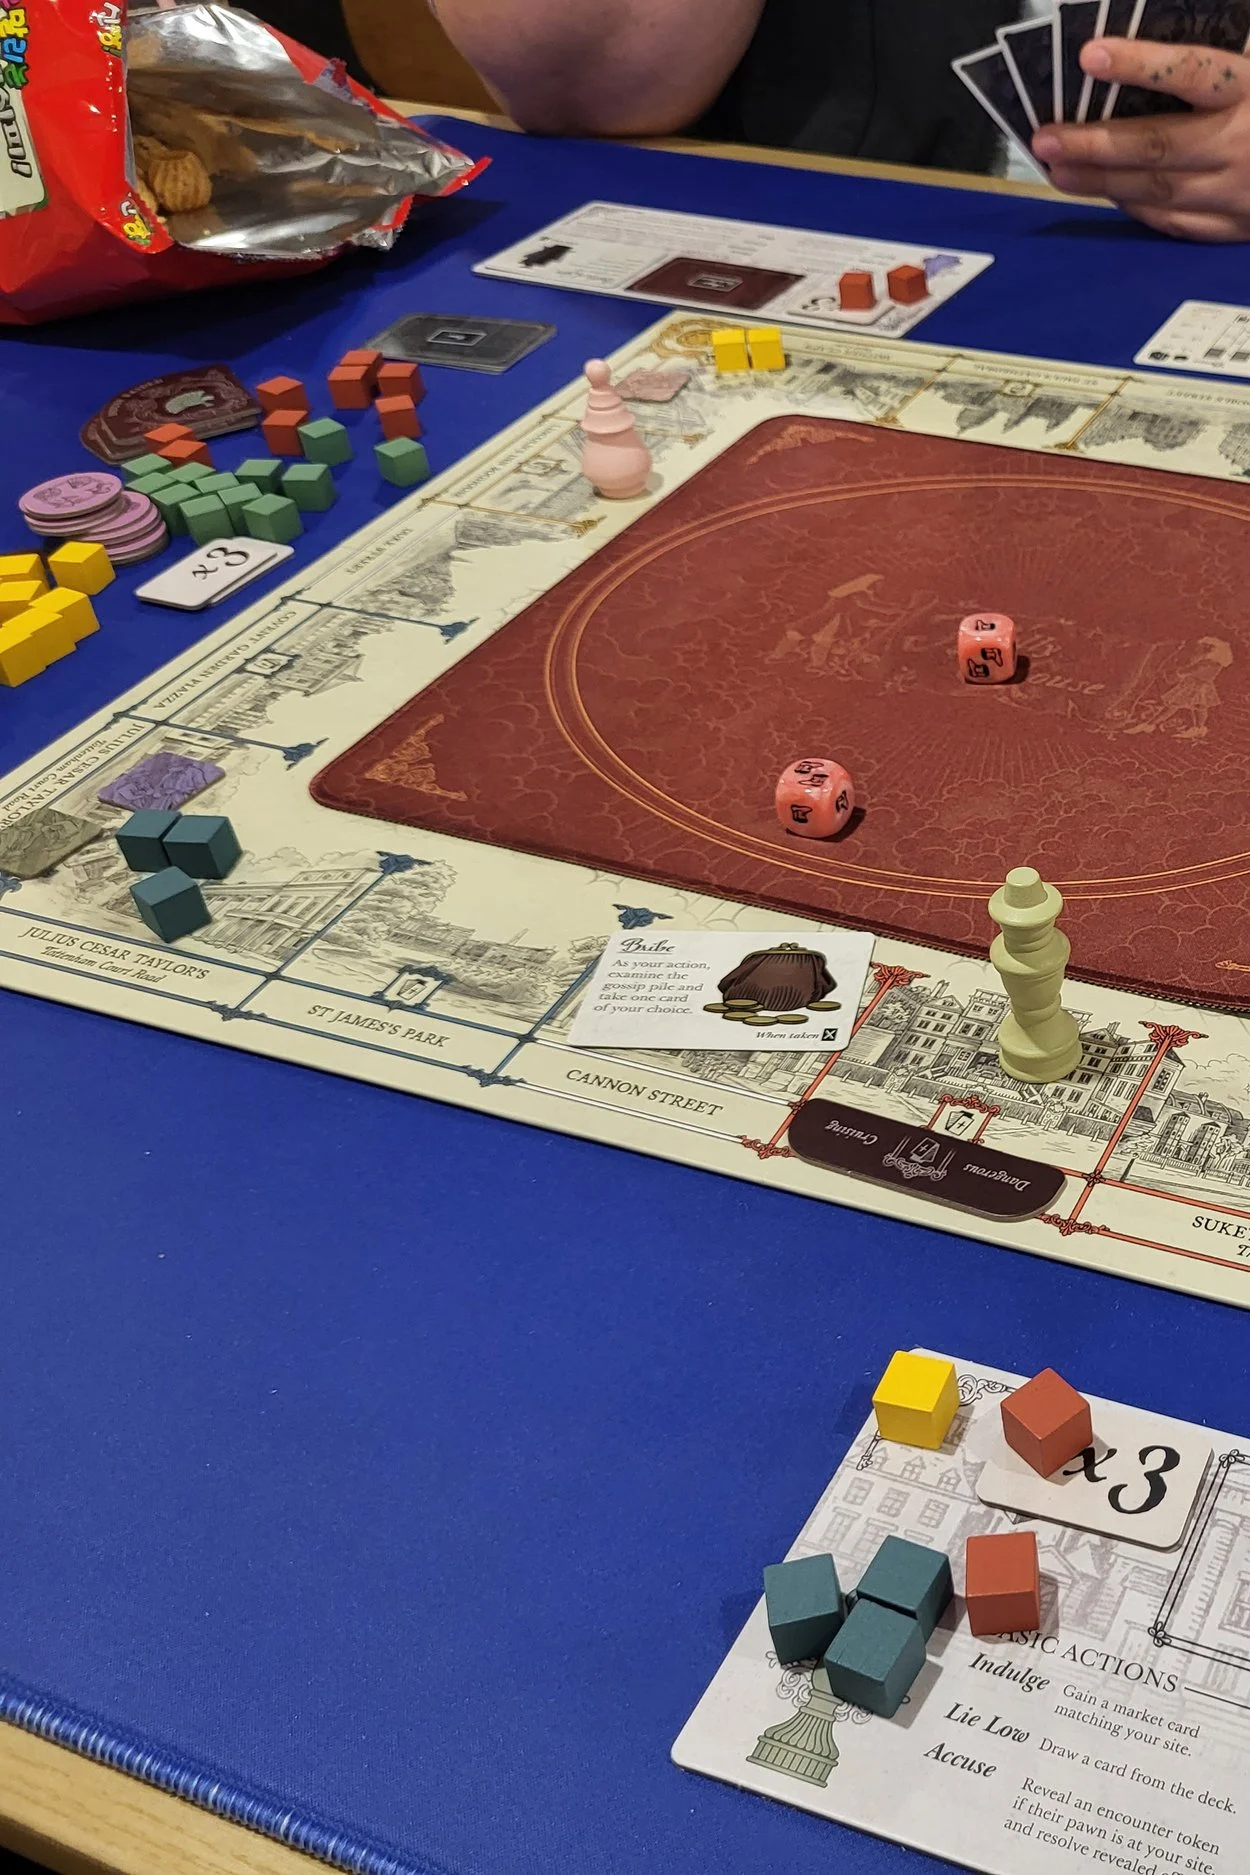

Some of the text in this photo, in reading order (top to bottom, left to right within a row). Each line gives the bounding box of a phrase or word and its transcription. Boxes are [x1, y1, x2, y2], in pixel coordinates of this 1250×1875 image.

[191, 546, 250, 580] x3
[249, 610, 298, 645] COVENT
[199, 644, 249, 679] GARDEN
[57, 723, 145, 786] JULIUS CESAR
[19, 925, 211, 982] JULIUS CESAR TAYLOR'S
[40, 945, 164, 984] Tottenham Court Road
[611, 959, 711, 970] As your action,
[620, 937, 676, 954] Bribe
[602, 982, 704, 992] gossip pile and
[607, 970, 689, 980] examine the
[593, 1003, 693, 1015] of your choice.
[598, 993, 689, 1002] take one card
[307, 1003, 452, 1048] ST JAMES'S PARK
[756, 1030, 820, 1039] When taken
[564, 1067, 724, 1117] CANNON STREET
[823, 1118, 1031, 1194] Dangerous Cruising
[1062, 1445, 1181, 1515] x3
[968, 1652, 1052, 1694] Indulge
[997, 1629, 1179, 1694] ASIC ACTIONS
[944, 1702, 1031, 1745] Lie Low
[1054, 1703, 1193, 1758] matching your site.
[1063, 1684, 1201, 1739] Gain a market card
[923, 1741, 998, 1779] Accuse
[1039, 1737, 1238, 1817] Draw a card from the deck.
[1012, 1795, 1028, 1812] if
[1026, 1801, 1063, 1825] their
[1063, 1816, 1108, 1841] pawn
[1110, 1828, 1125, 1845] is
[1126, 1835, 1144, 1852] at
[1145, 1841, 1184, 1866] your
[1183, 1852, 1216, 1875] site.
[1021, 1776, 1220, 1857] Reveal an encounter token
[1003, 1816, 1035, 1838] and
[1036, 1827, 1090, 1857] resolve
[1092, 1848, 1157, 1875] revealed
